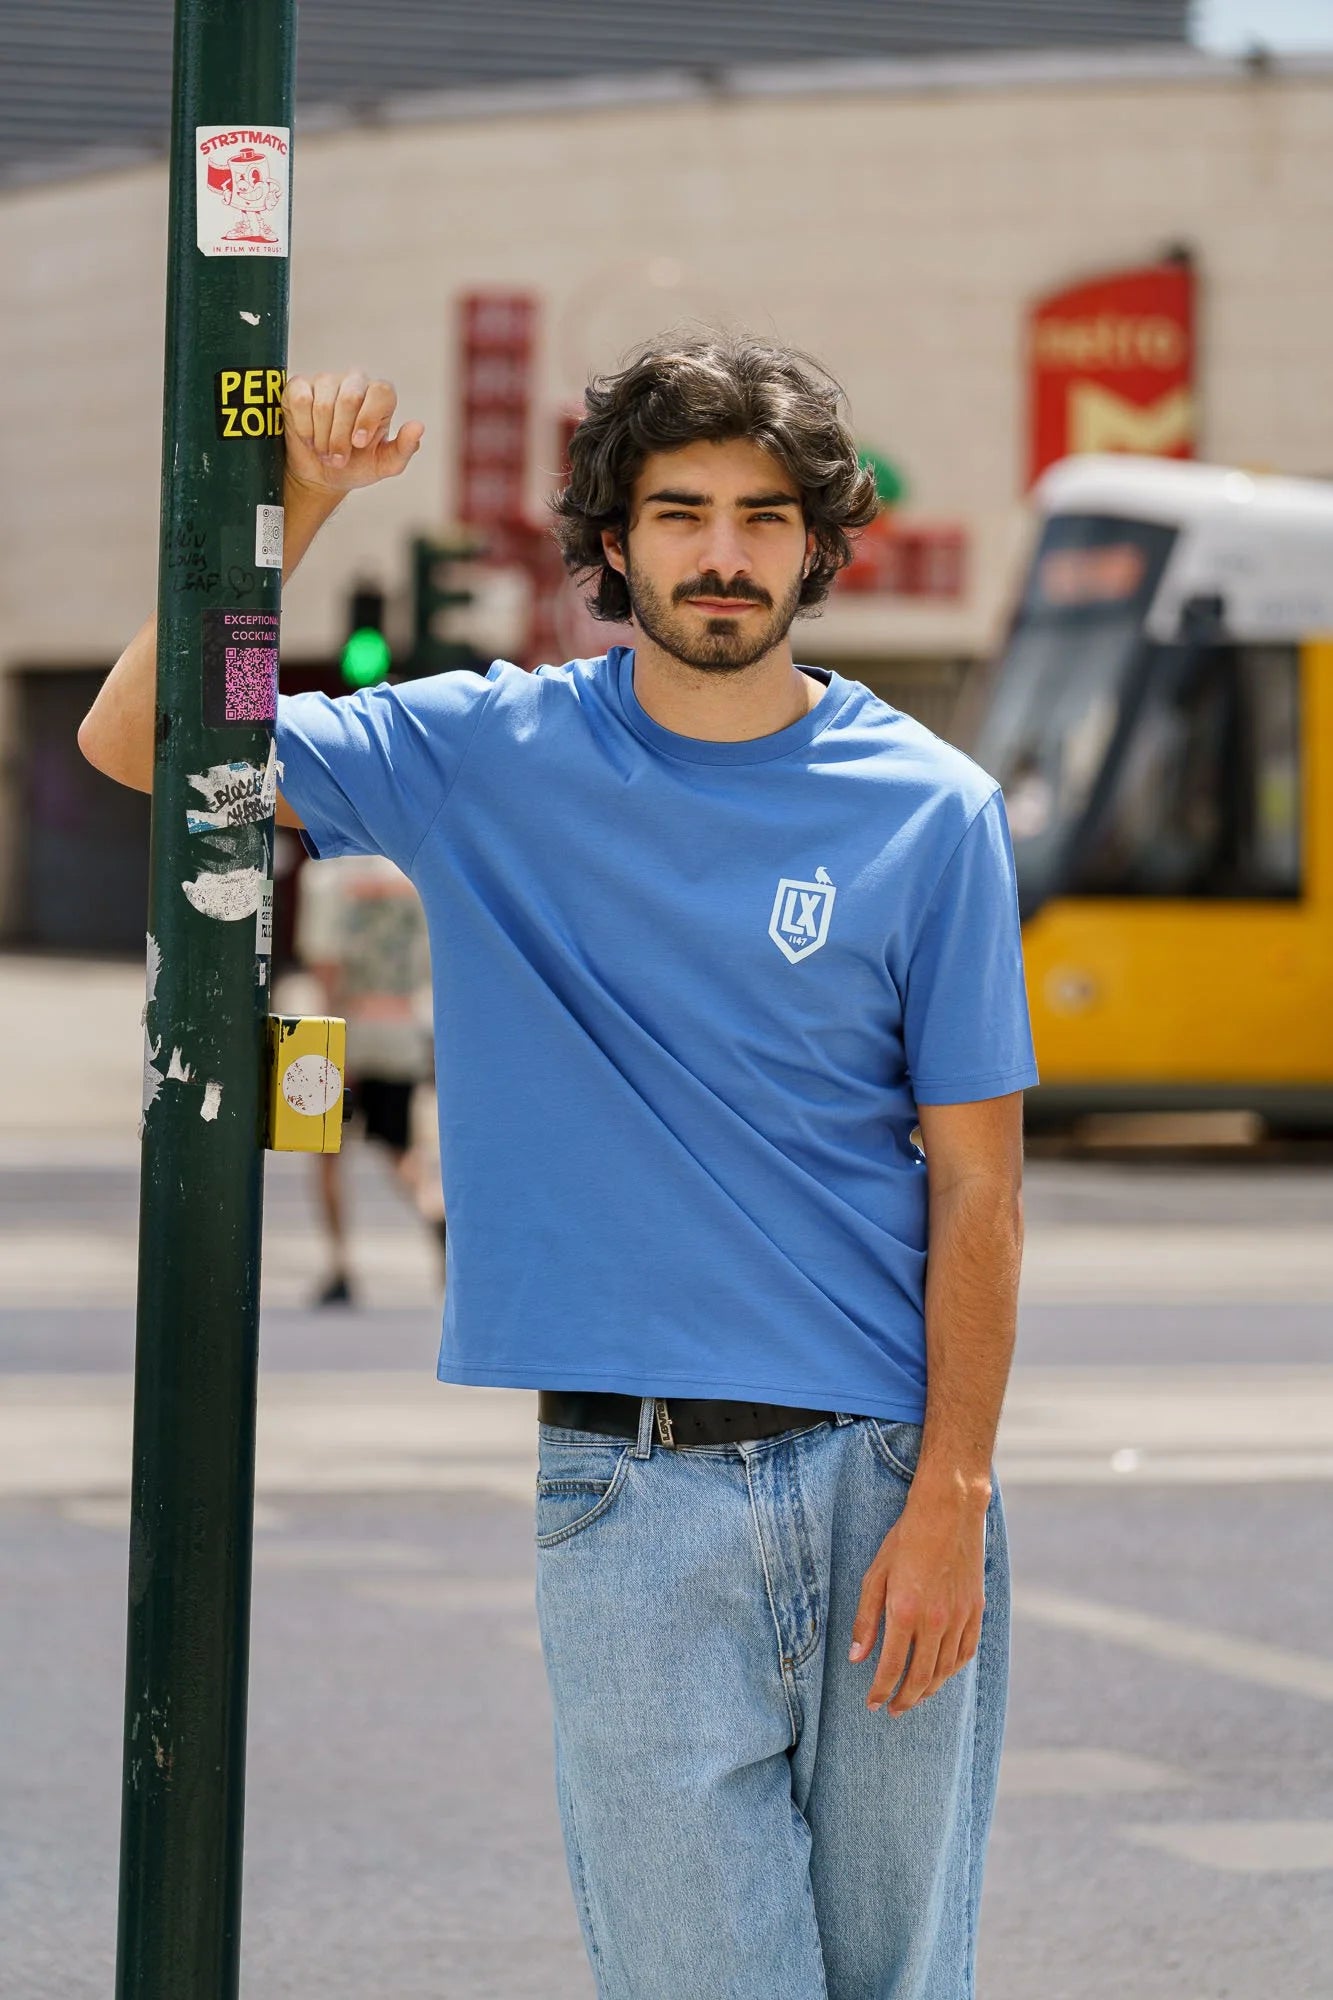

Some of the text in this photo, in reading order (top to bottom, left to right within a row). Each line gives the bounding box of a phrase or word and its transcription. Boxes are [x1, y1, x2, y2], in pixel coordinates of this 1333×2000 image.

[200, 130, 288, 155] STR3TMATIC
[232, 631, 276, 640] COCKTAILS
[781, 890, 821, 938] LX
[789, 935, 807, 946] 1147
